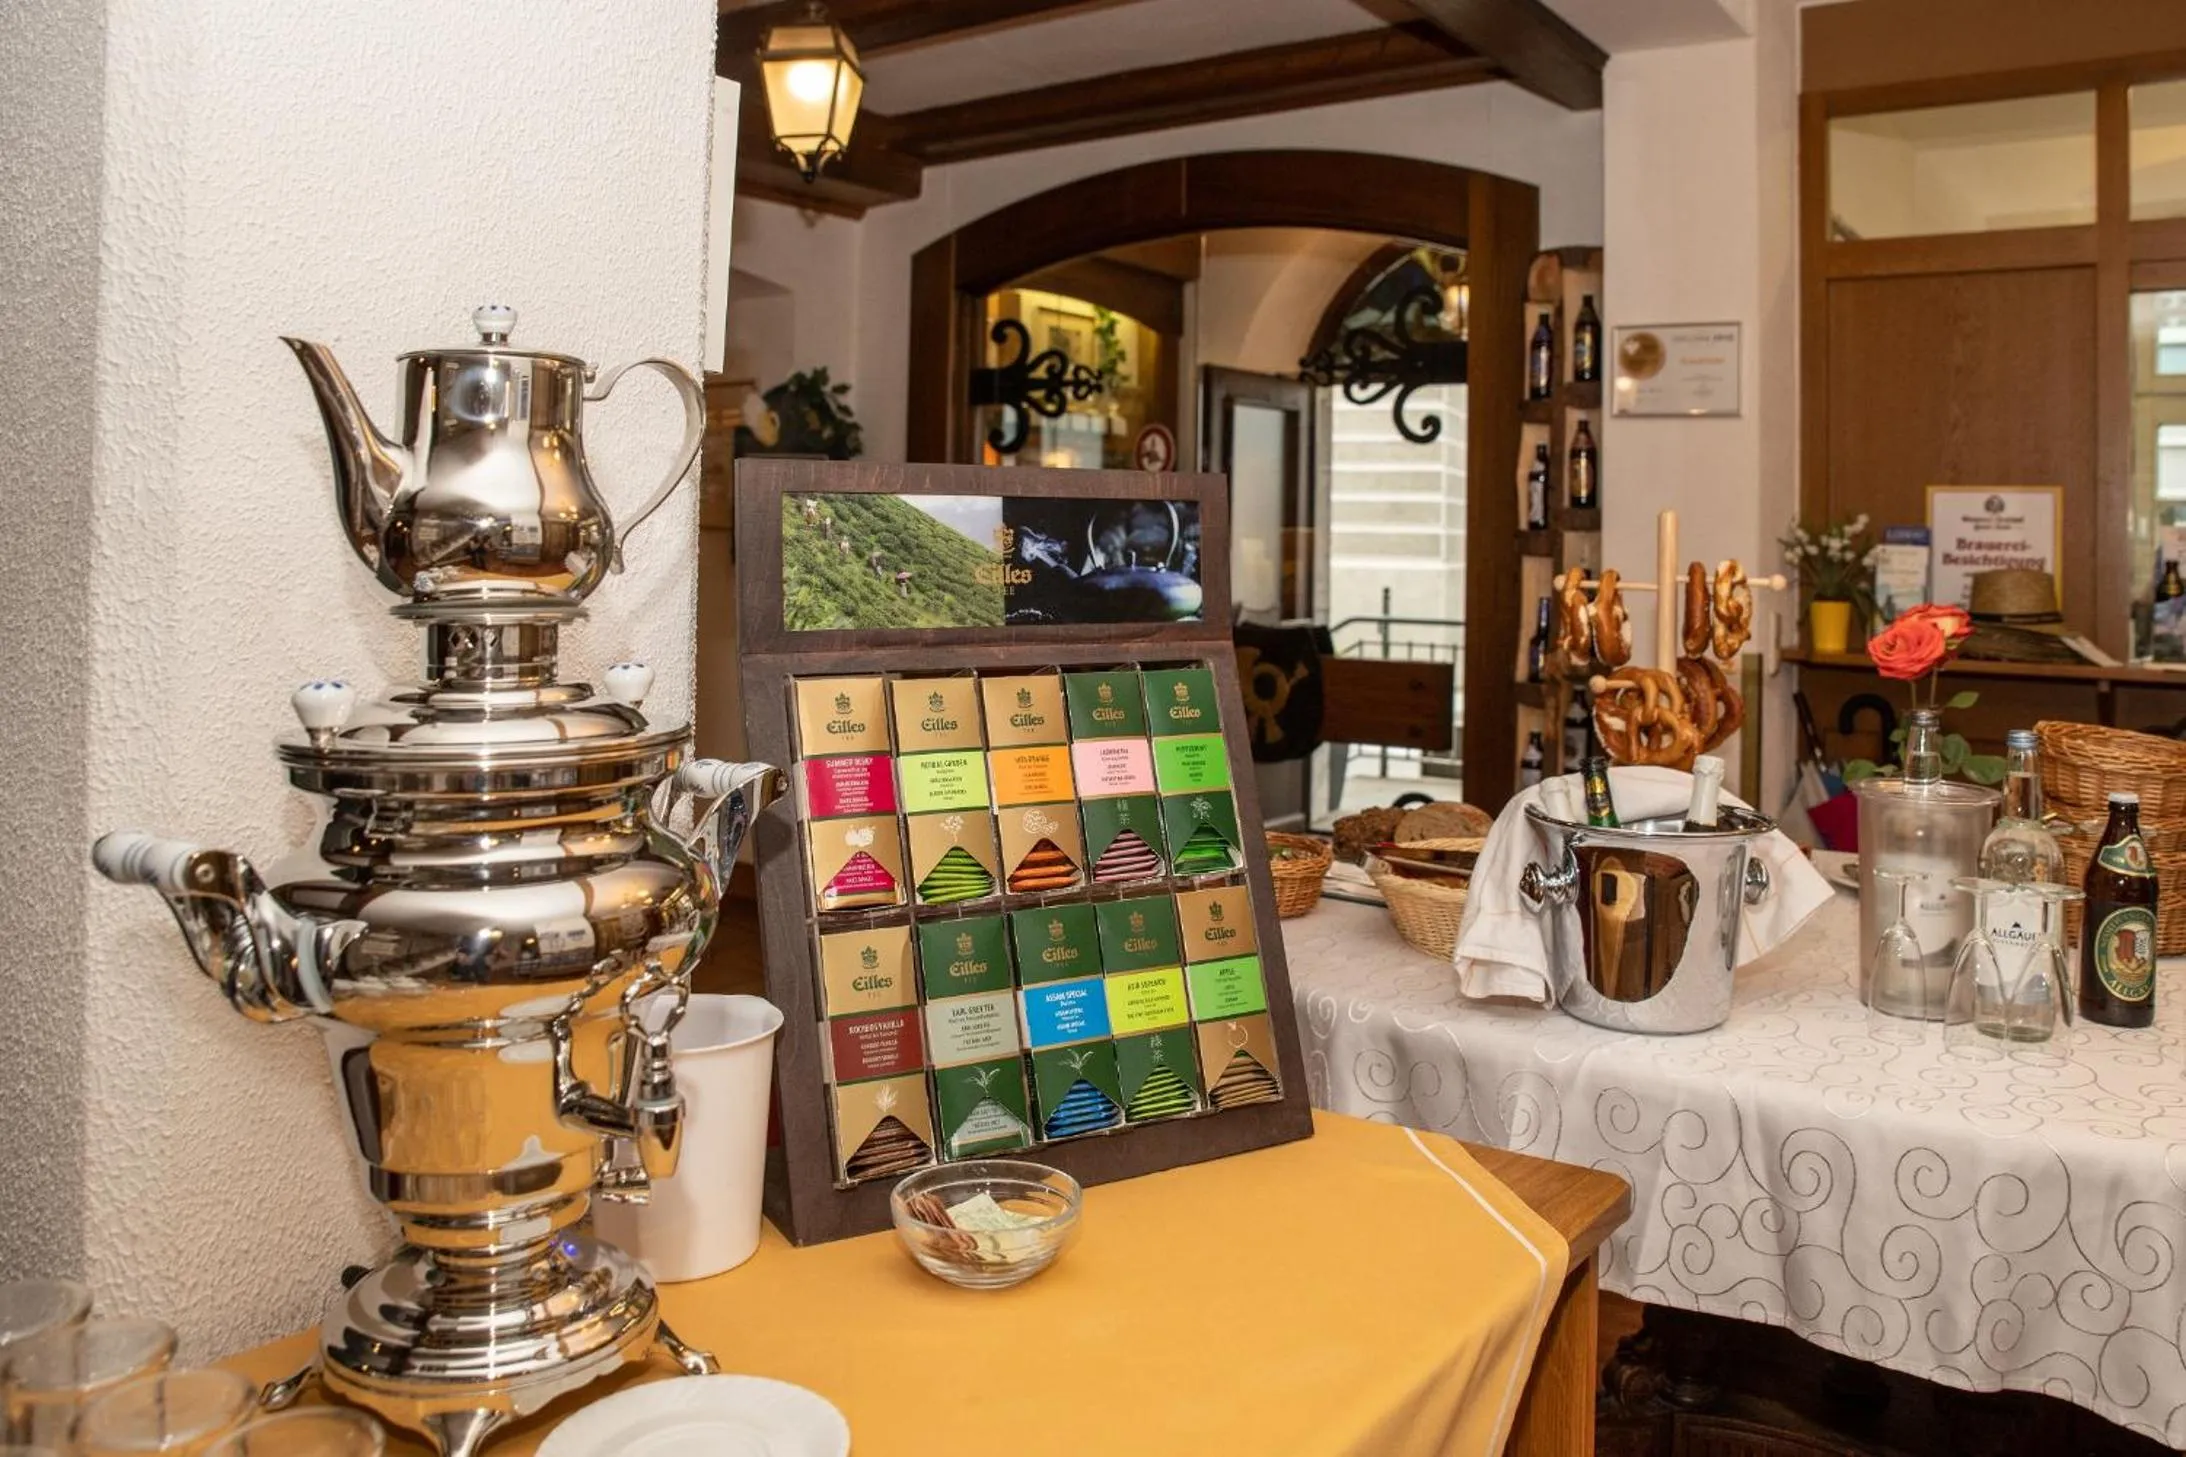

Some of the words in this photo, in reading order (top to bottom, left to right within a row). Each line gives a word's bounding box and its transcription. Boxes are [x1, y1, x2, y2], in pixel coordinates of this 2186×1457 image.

[826, 719, 866, 735] Eilles
[921, 717, 958, 732] Eilles
[1010, 713, 1045, 728] Eilles
[1204, 926, 1237, 941] Eilles
[949, 960, 988, 977] Eilles
[852, 973, 894, 991] Eilles
